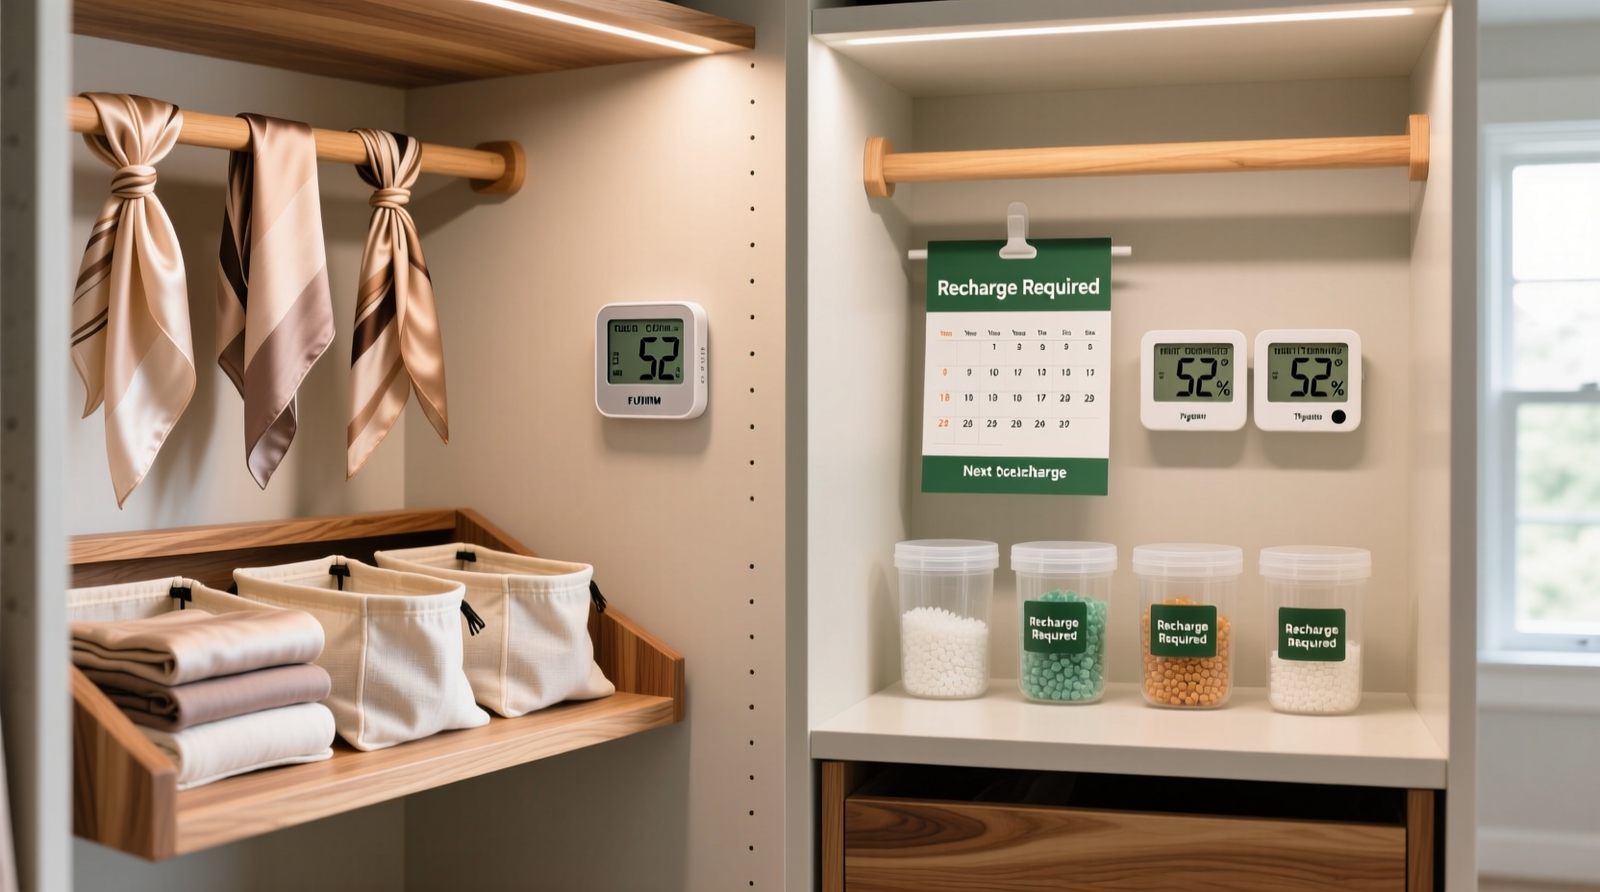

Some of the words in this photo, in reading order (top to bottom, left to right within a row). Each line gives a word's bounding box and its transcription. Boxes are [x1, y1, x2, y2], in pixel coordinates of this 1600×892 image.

[938, 279, 1018, 300] Recharge
[1022, 277, 1100, 300] Required
[639, 336, 680, 381] 52
[963, 465, 992, 477] Next
